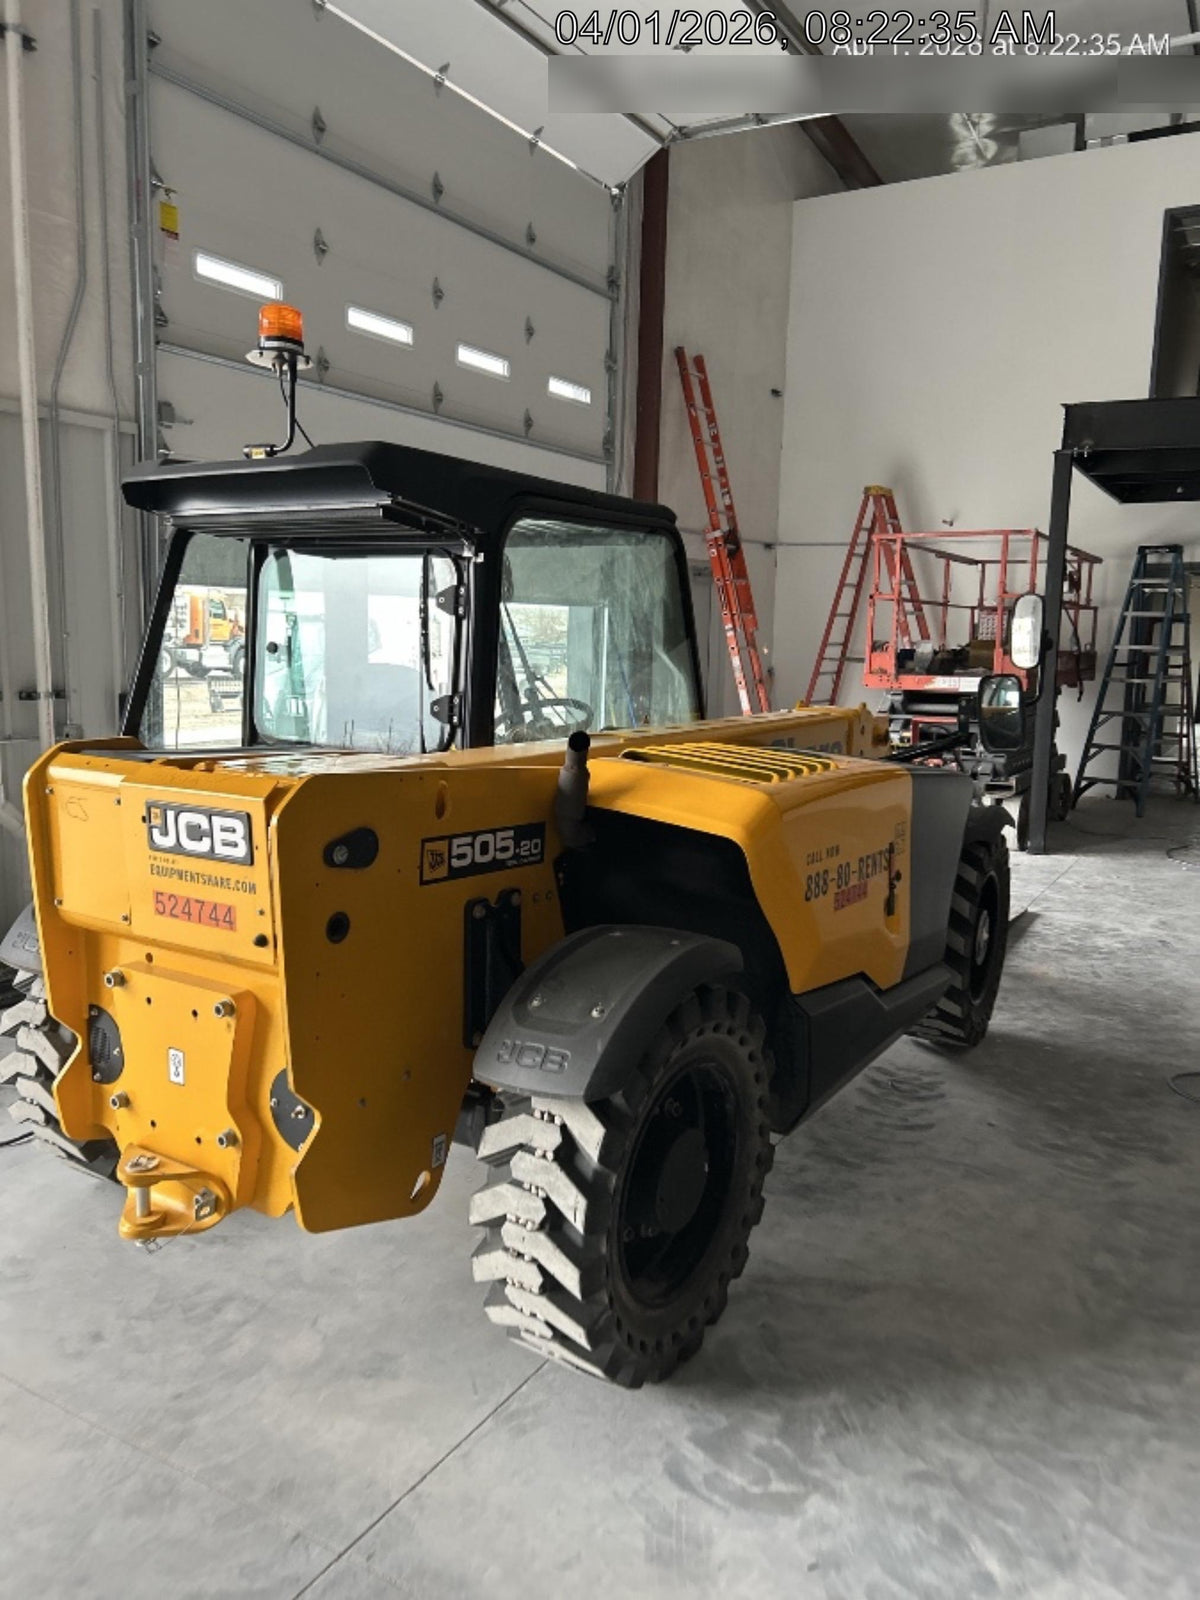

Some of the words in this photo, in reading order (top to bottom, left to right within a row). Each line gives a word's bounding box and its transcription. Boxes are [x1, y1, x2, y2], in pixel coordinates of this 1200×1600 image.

[151, 809, 247, 858] JCB
[806, 848, 823, 866] CALL
[149, 863, 257, 895] EQUIPMENTSHARE.COM
[154, 891, 235, 930] 524744
[497, 1038, 572, 1074] JCB
